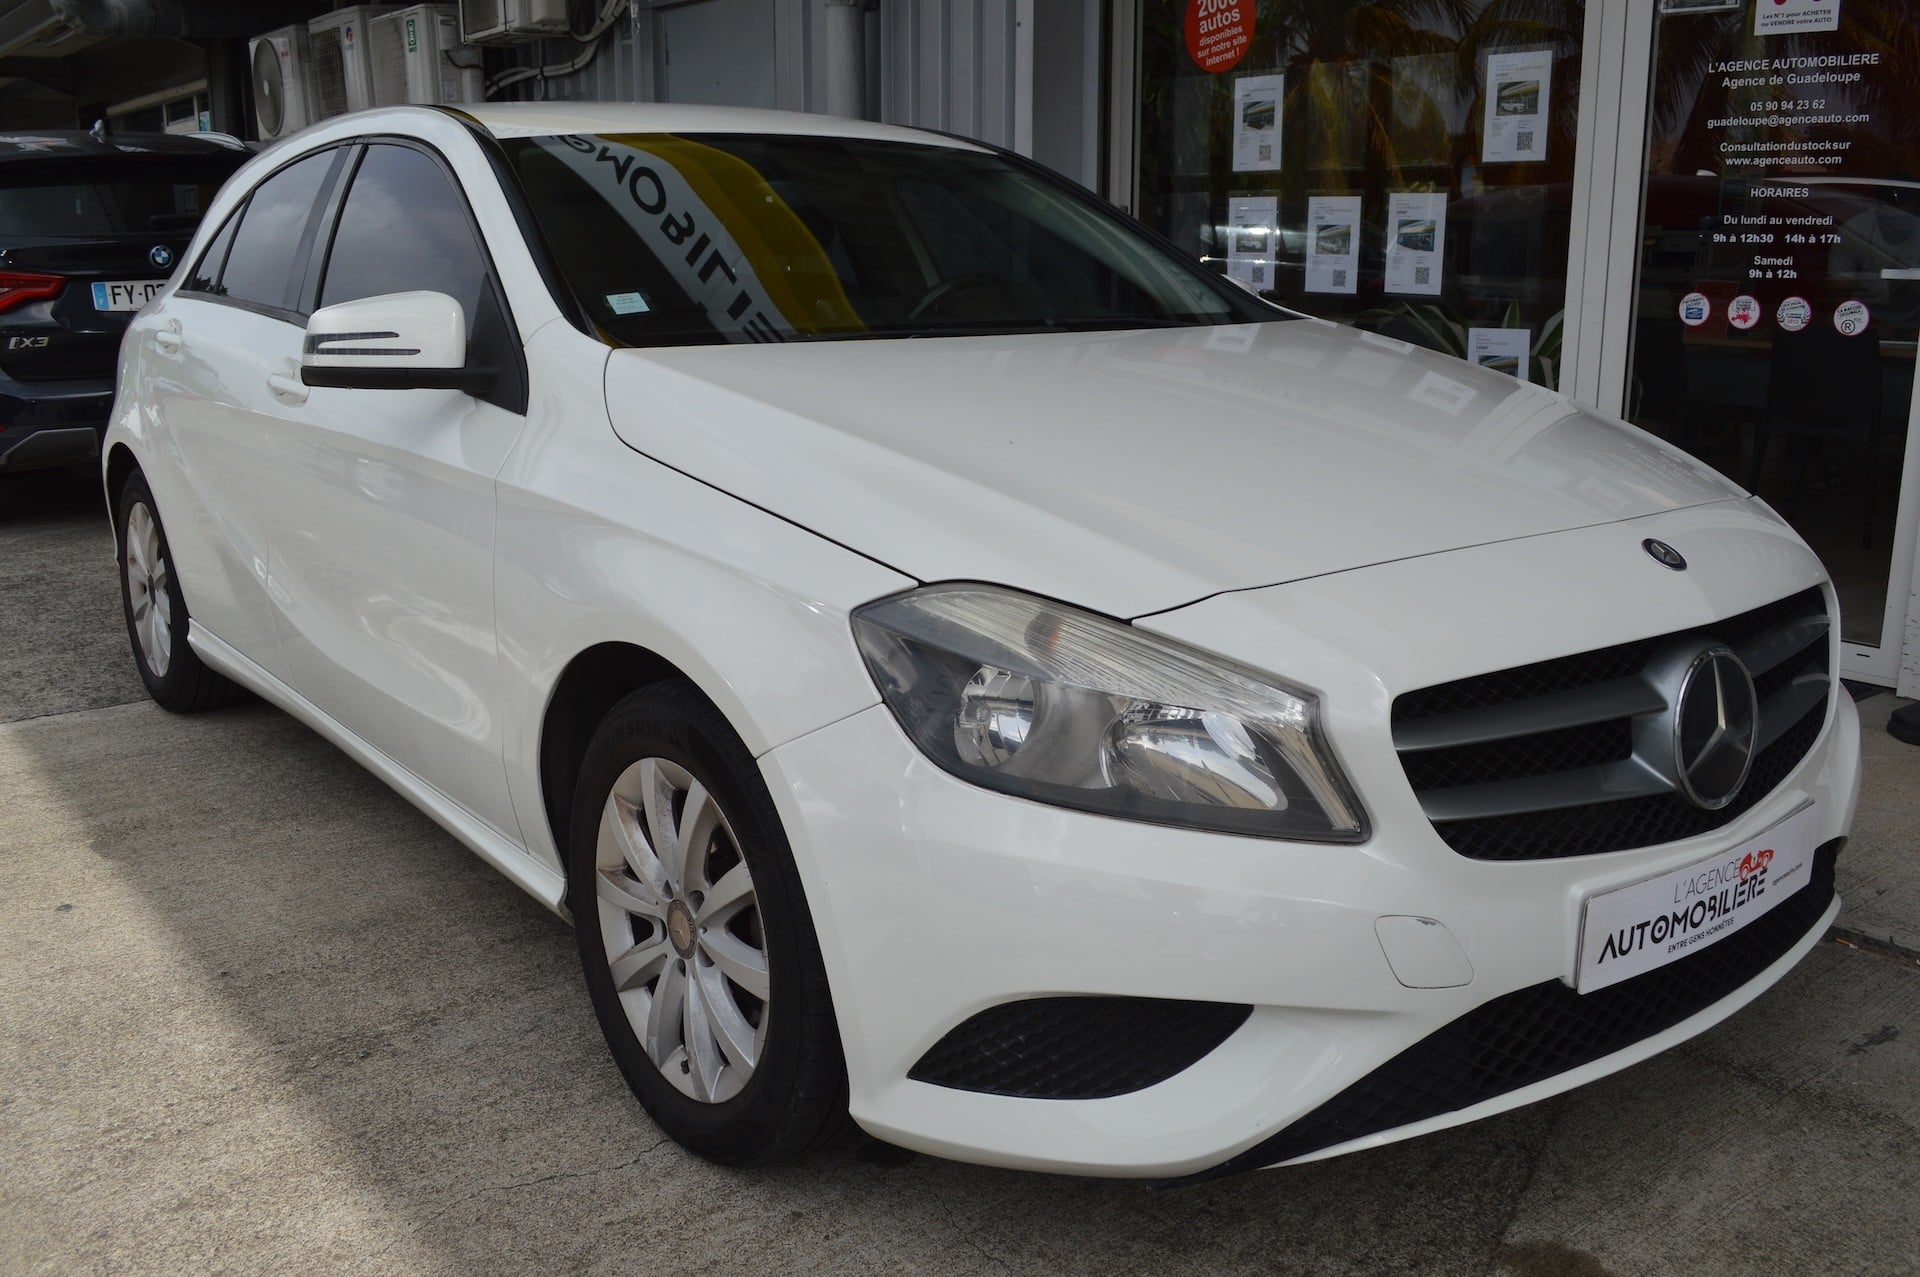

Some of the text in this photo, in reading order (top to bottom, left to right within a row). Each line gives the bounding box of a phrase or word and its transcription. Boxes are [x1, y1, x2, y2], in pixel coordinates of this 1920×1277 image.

[1802, 9, 1832, 17] ACHETER
[1200, 8, 1240, 34] autos
[1770, 19, 1794, 27] VENDRE
[1199, 25, 1243, 46] disponibles
[1197, 35, 1248, 58] sur notre site
[1206, 51, 1236, 66] internet
[1708, 53, 1880, 74] L'AGENCE AUTOMOBILIERE
[1722, 72, 1861, 89] Agence de Guadeloupe
[1750, 99, 1826, 112] 05 90 94 23 62
[1707, 113, 1870, 129] guadeloupe@agenceauto.com
[1725, 155, 1842, 168] www.agenceauto.com
[1750, 188, 1809, 198] HORAIRES
[1723, 214, 1833, 226] Du lundi au vendredi
[1712, 233, 1841, 243] 9h à 12h30 14h à 17h
[1753, 255, 1793, 266] Samedi
[1748, 269, 1797, 279] 9h à 12h
[1674, 857, 1741, 903] L'AGENCE
[1598, 868, 1767, 964] AUTOMOBILIERE
[1668, 939, 1687, 953] ENTRE
[1689, 931, 1705, 945] GENS
